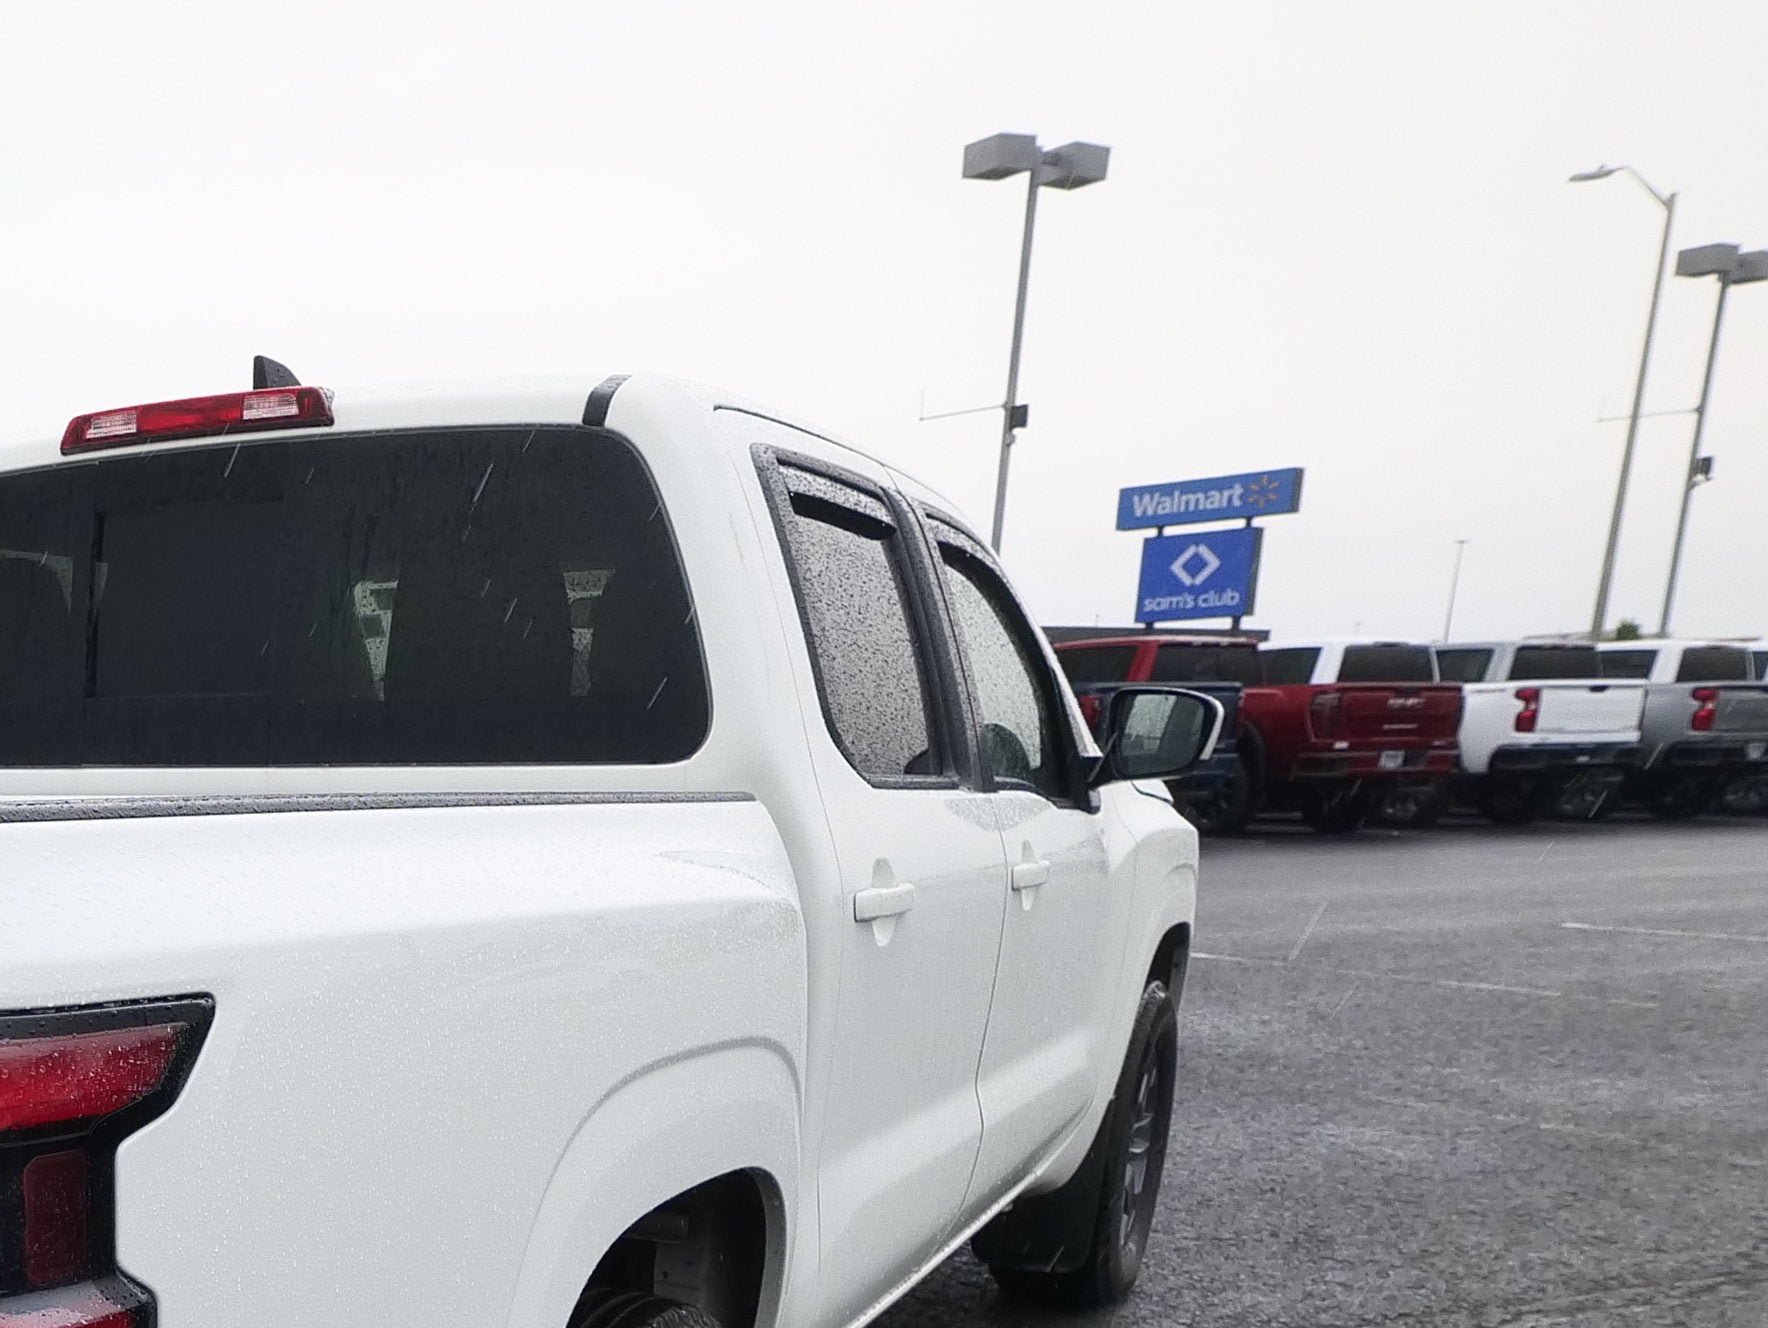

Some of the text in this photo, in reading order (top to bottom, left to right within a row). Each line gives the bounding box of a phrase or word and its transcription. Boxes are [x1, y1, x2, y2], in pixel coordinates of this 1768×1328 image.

[1134, 483, 1245, 517] Walmart
[1144, 588, 1240, 611] sam's club
